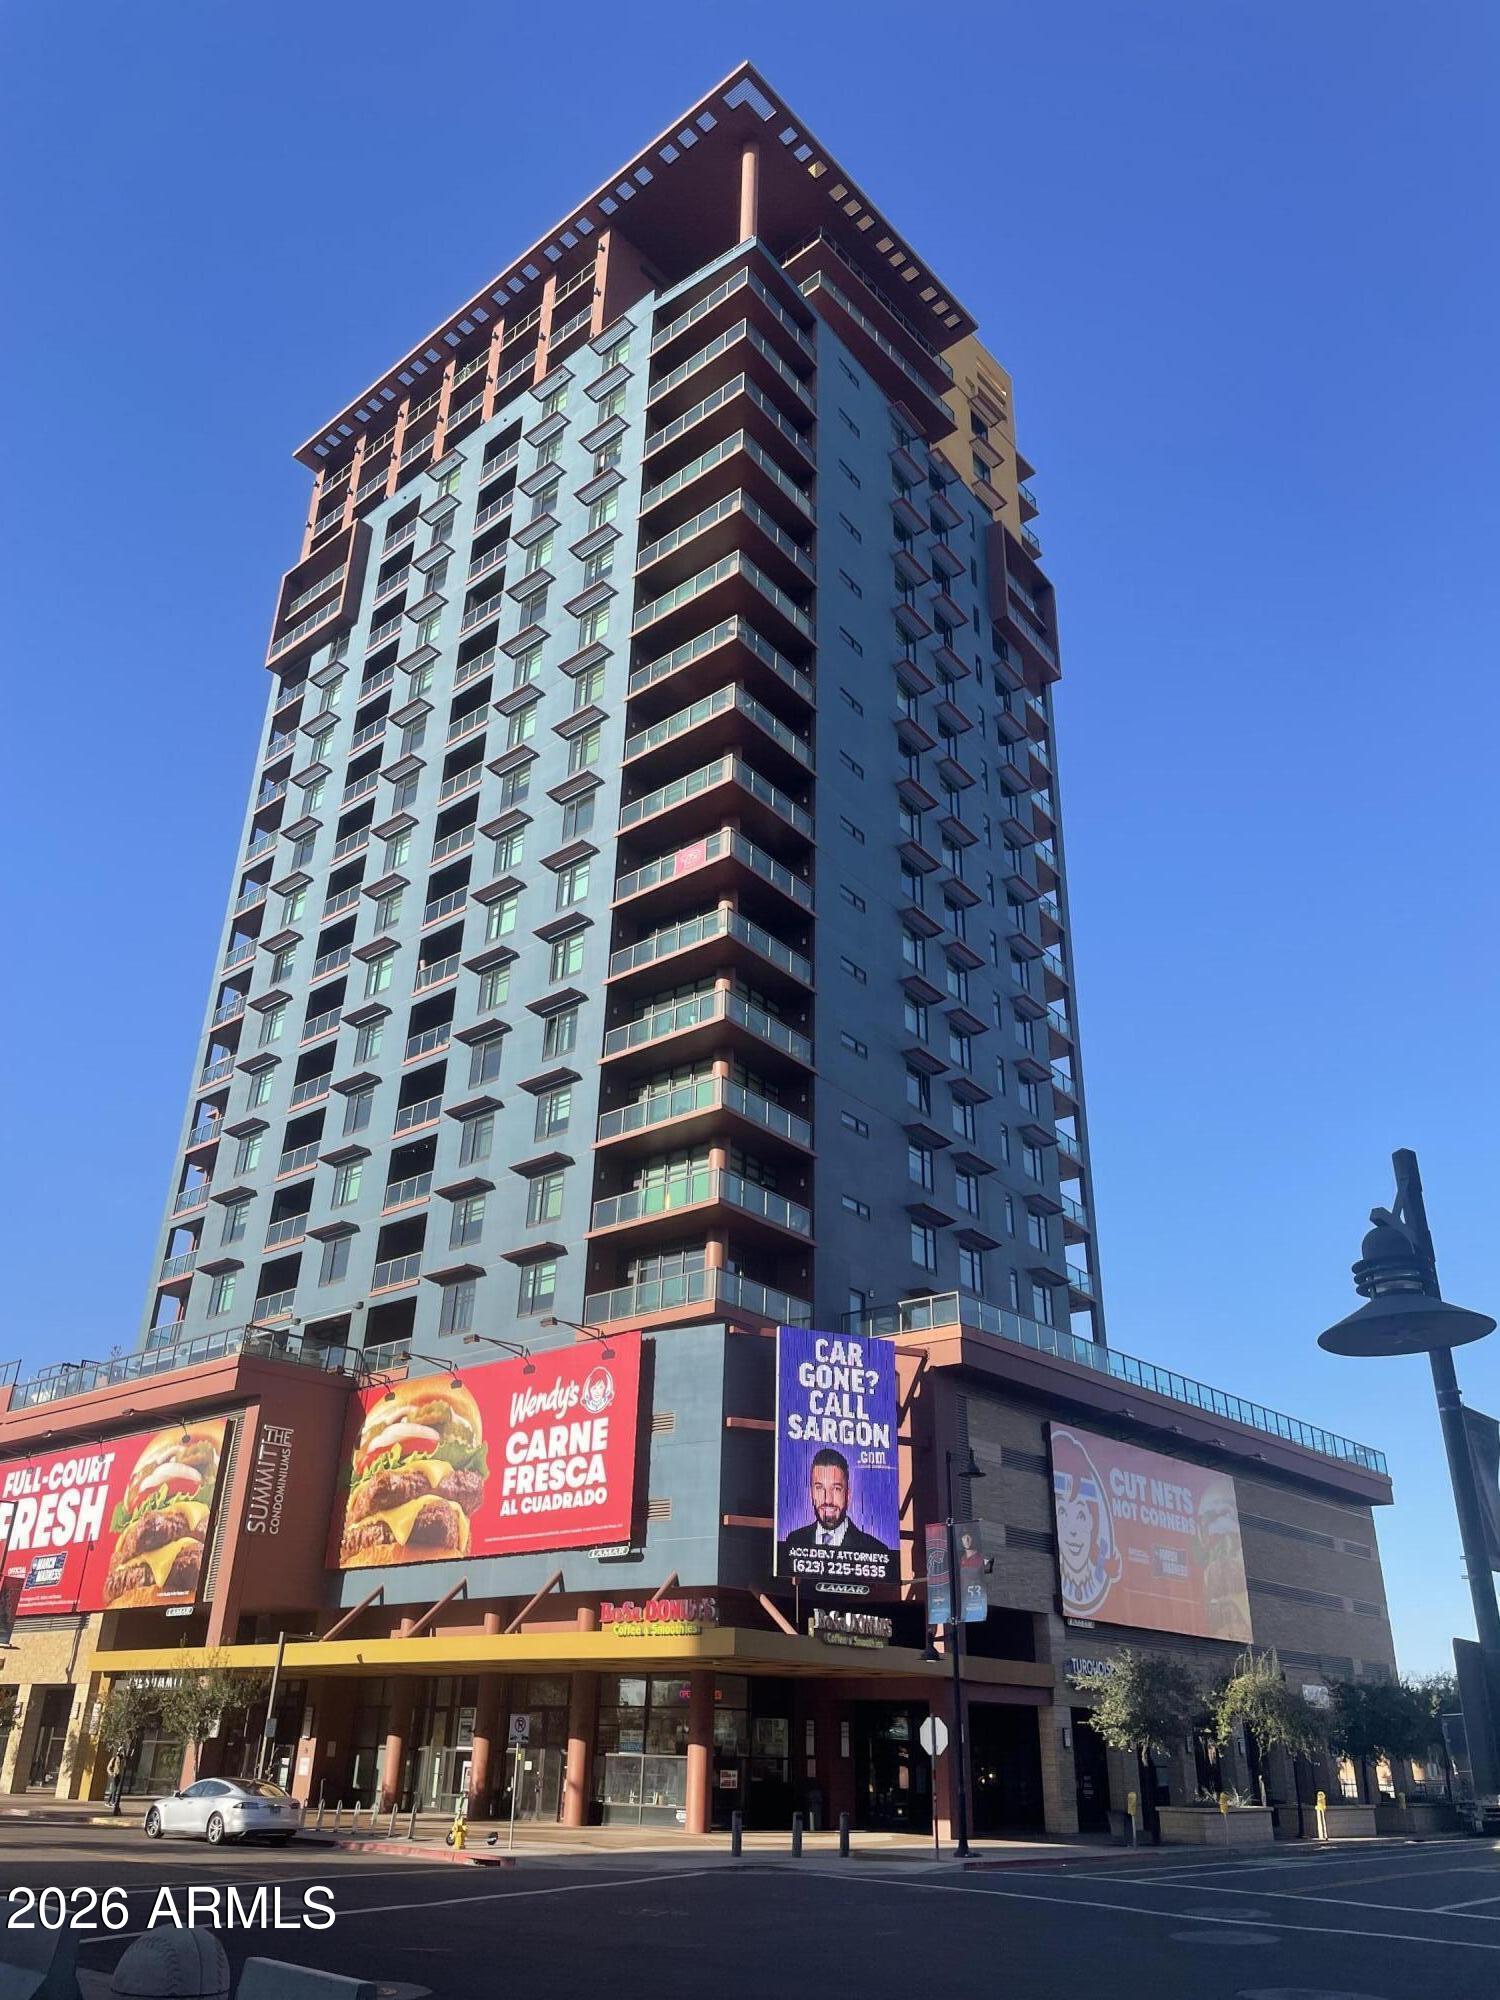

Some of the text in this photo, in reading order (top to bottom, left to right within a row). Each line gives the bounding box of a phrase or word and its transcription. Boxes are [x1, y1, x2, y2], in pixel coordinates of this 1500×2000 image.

[815, 1338, 864, 1368] CAR
[799, 1362, 880, 1395] GONE?
[509, 1376, 580, 1429] Wendy's
[809, 1389, 870, 1421] CALL
[264, 1427, 293, 1446] THE
[505, 1417, 609, 1465] CARNE
[787, 1413, 890, 1449] SARGON
[2, 1452, 116, 1499] FULL-COURT
[247, 1443, 278, 1533] SUMMIT
[269, 1448, 291, 1535] CONDOMINIUMS
[502, 1453, 607, 1496] FRESCA
[1109, 1467, 1194, 1514] CUT NETS
[499, 1487, 608, 1517] AL CUADRADO
[1112, 1497, 1197, 1536] NOT CORNERS
[788, 1547, 890, 1564] ACCIDENT ATTORNEYS
[793, 1558, 886, 1578] (623) 225-5635
[819, 1583, 865, 1594] LAMAR
